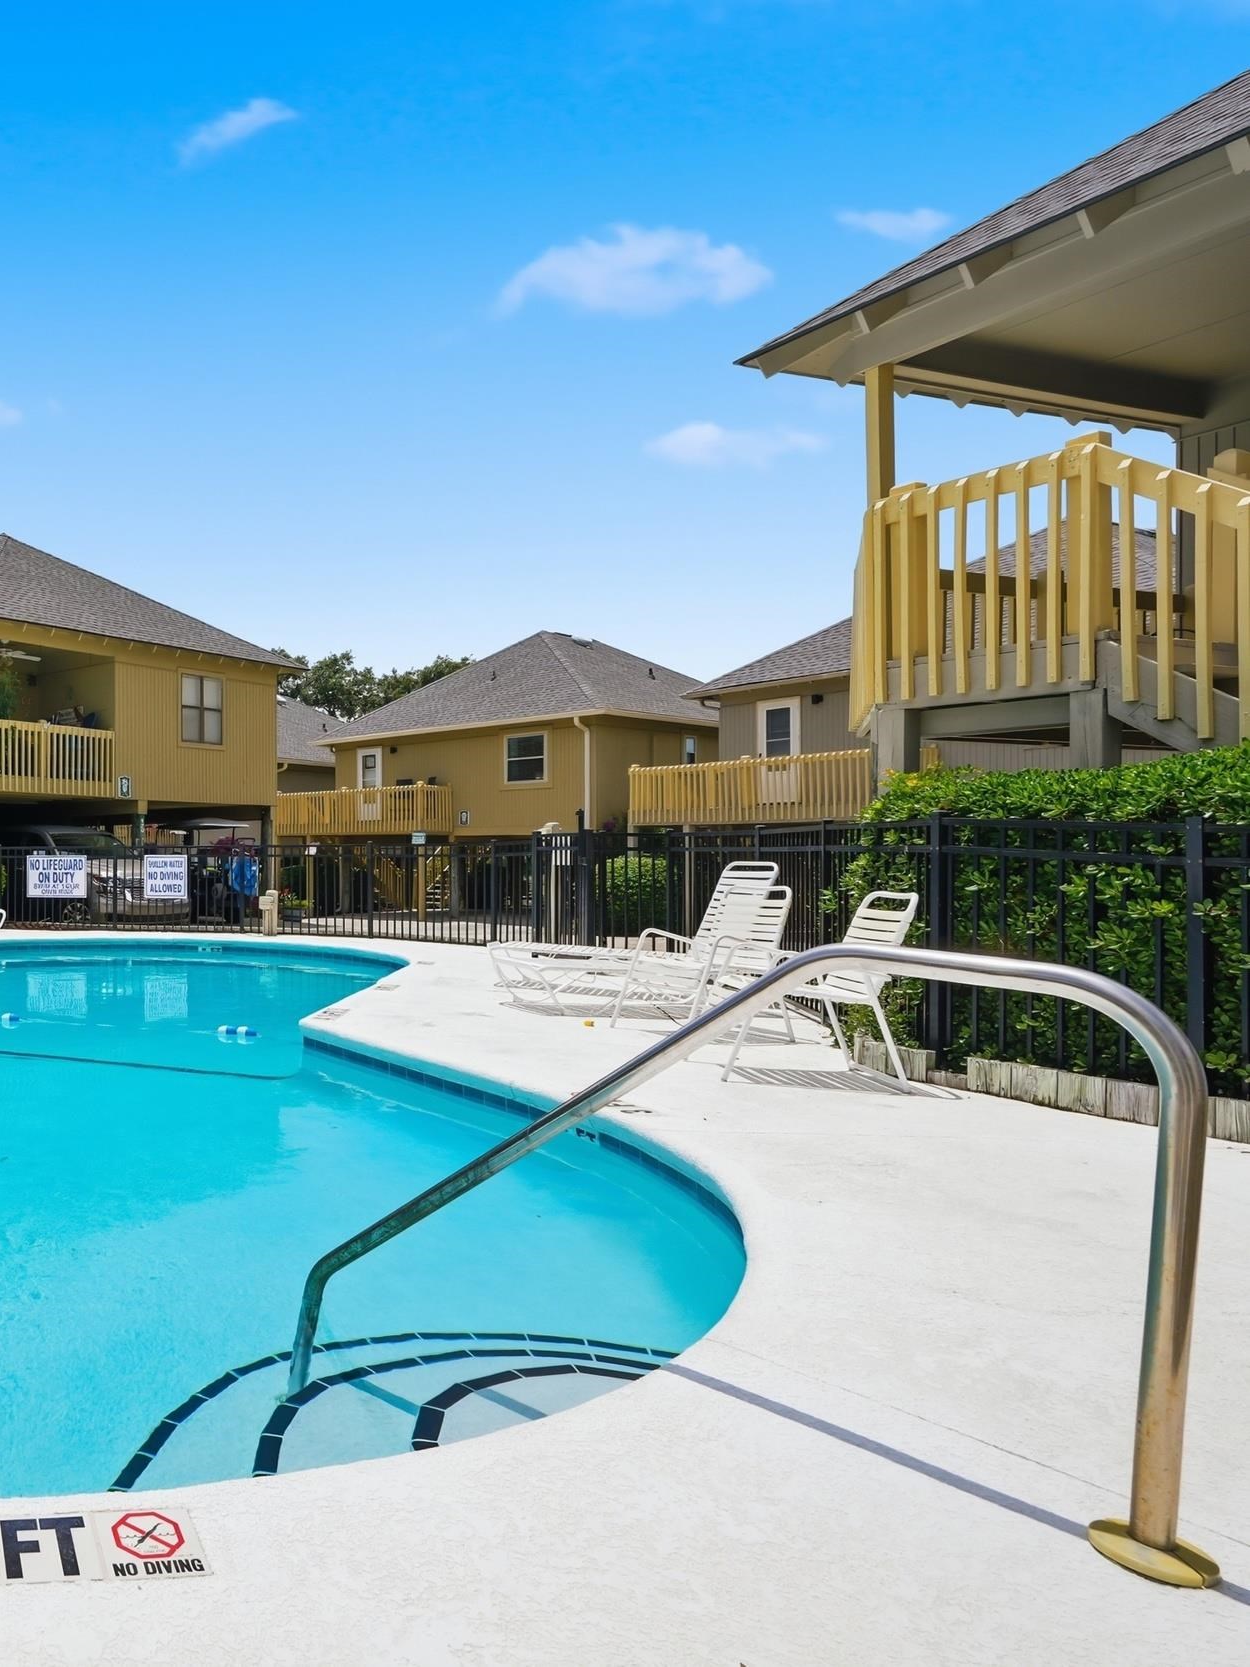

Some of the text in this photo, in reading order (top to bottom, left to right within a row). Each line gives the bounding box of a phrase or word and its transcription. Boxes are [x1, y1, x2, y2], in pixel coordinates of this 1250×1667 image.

[30, 859, 84, 871] NO LIFEGUARD
[38, 872, 75, 883] ON DUTY
[148, 871, 183, 881] NO DIVING
[150, 884, 182, 893] ALLOWED
[0, 1516, 86, 1579] FT
[112, 1558, 205, 1577] NO DIVING
